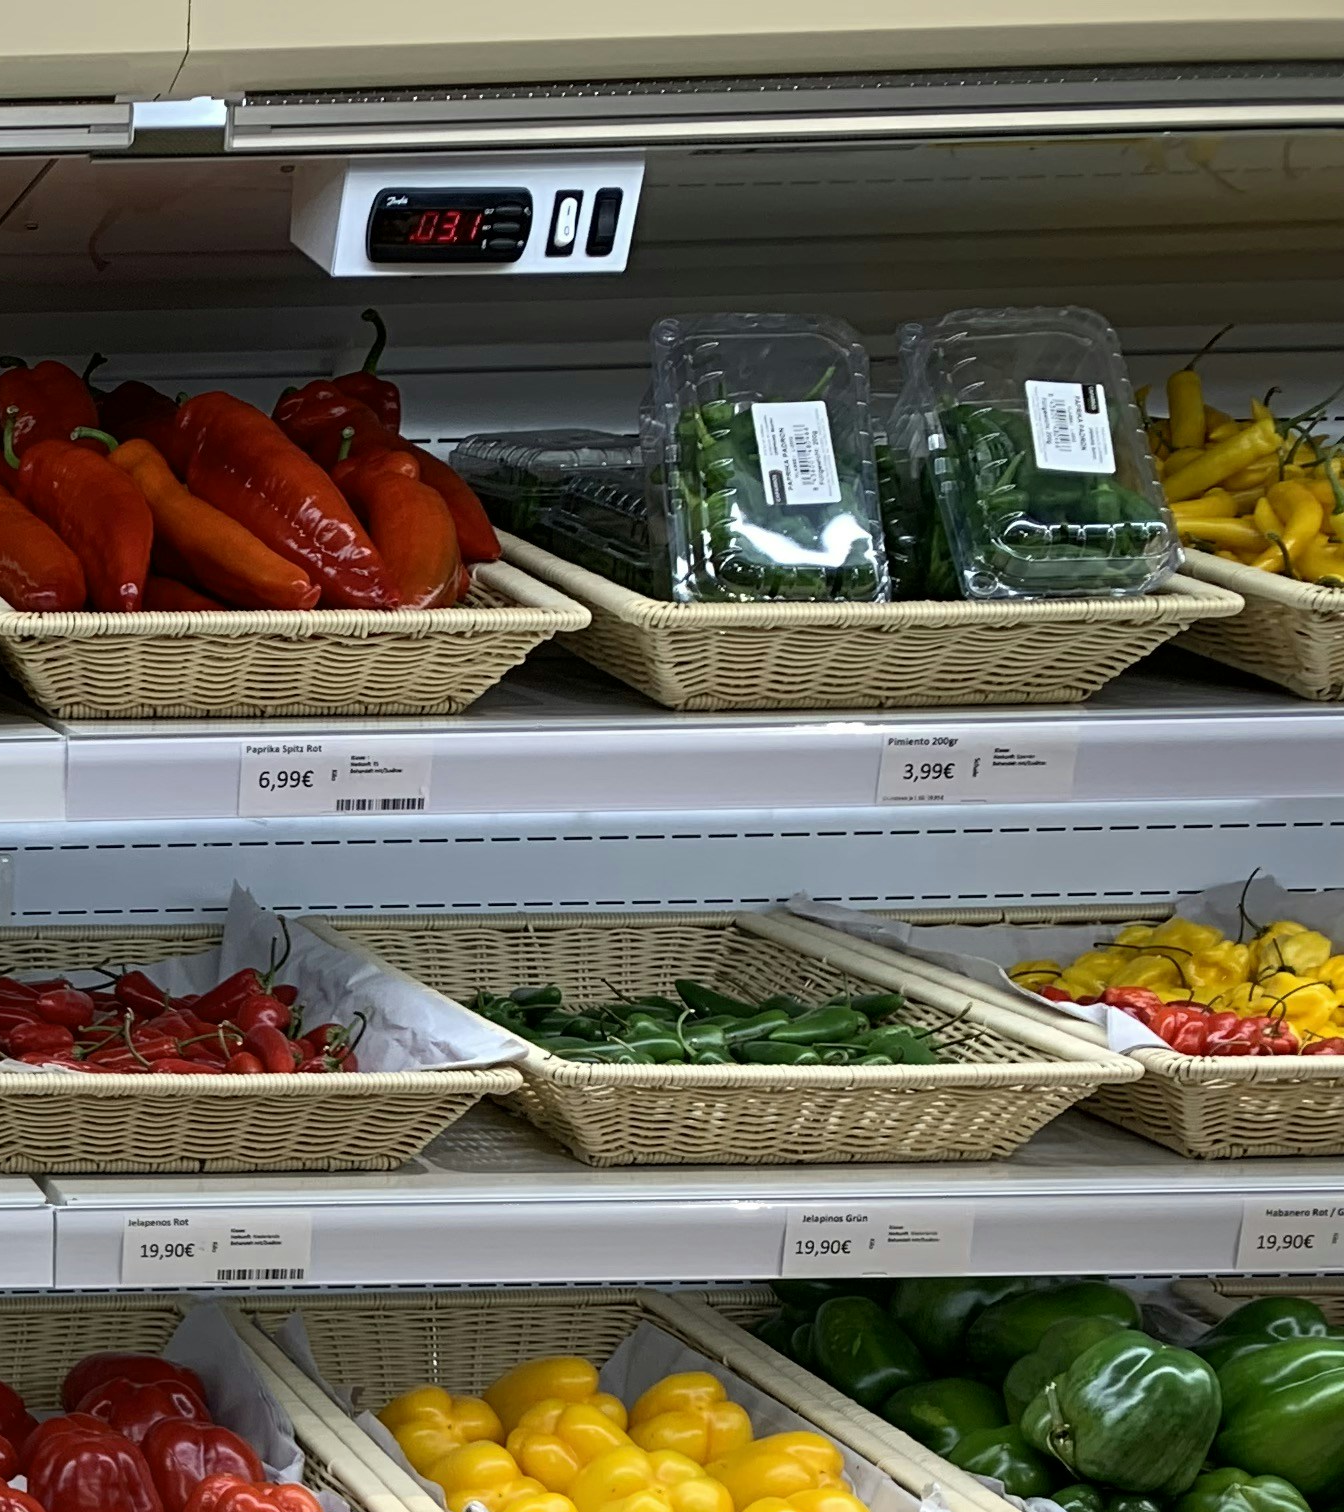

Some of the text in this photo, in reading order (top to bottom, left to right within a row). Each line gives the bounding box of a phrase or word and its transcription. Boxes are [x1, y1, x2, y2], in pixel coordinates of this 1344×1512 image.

[932, 737, 958, 747] 200gr
[247, 745, 279, 754] Paprika
[283, 745, 303, 754] Spitz
[903, 763, 955, 782] 3,99€
[259, 771, 314, 791] 6,99€
[846, 1214, 868, 1222] Grün
[1266, 1209, 1310, 1217] Habanero
[1312, 1208, 1328, 1216] Rot
[129, 1219, 171, 1227] Jelapenos
[796, 1240, 851, 1256] 19,90€
[1257, 1235, 1315, 1251] 19,90€
[141, 1243, 195, 1260] 19,90€
